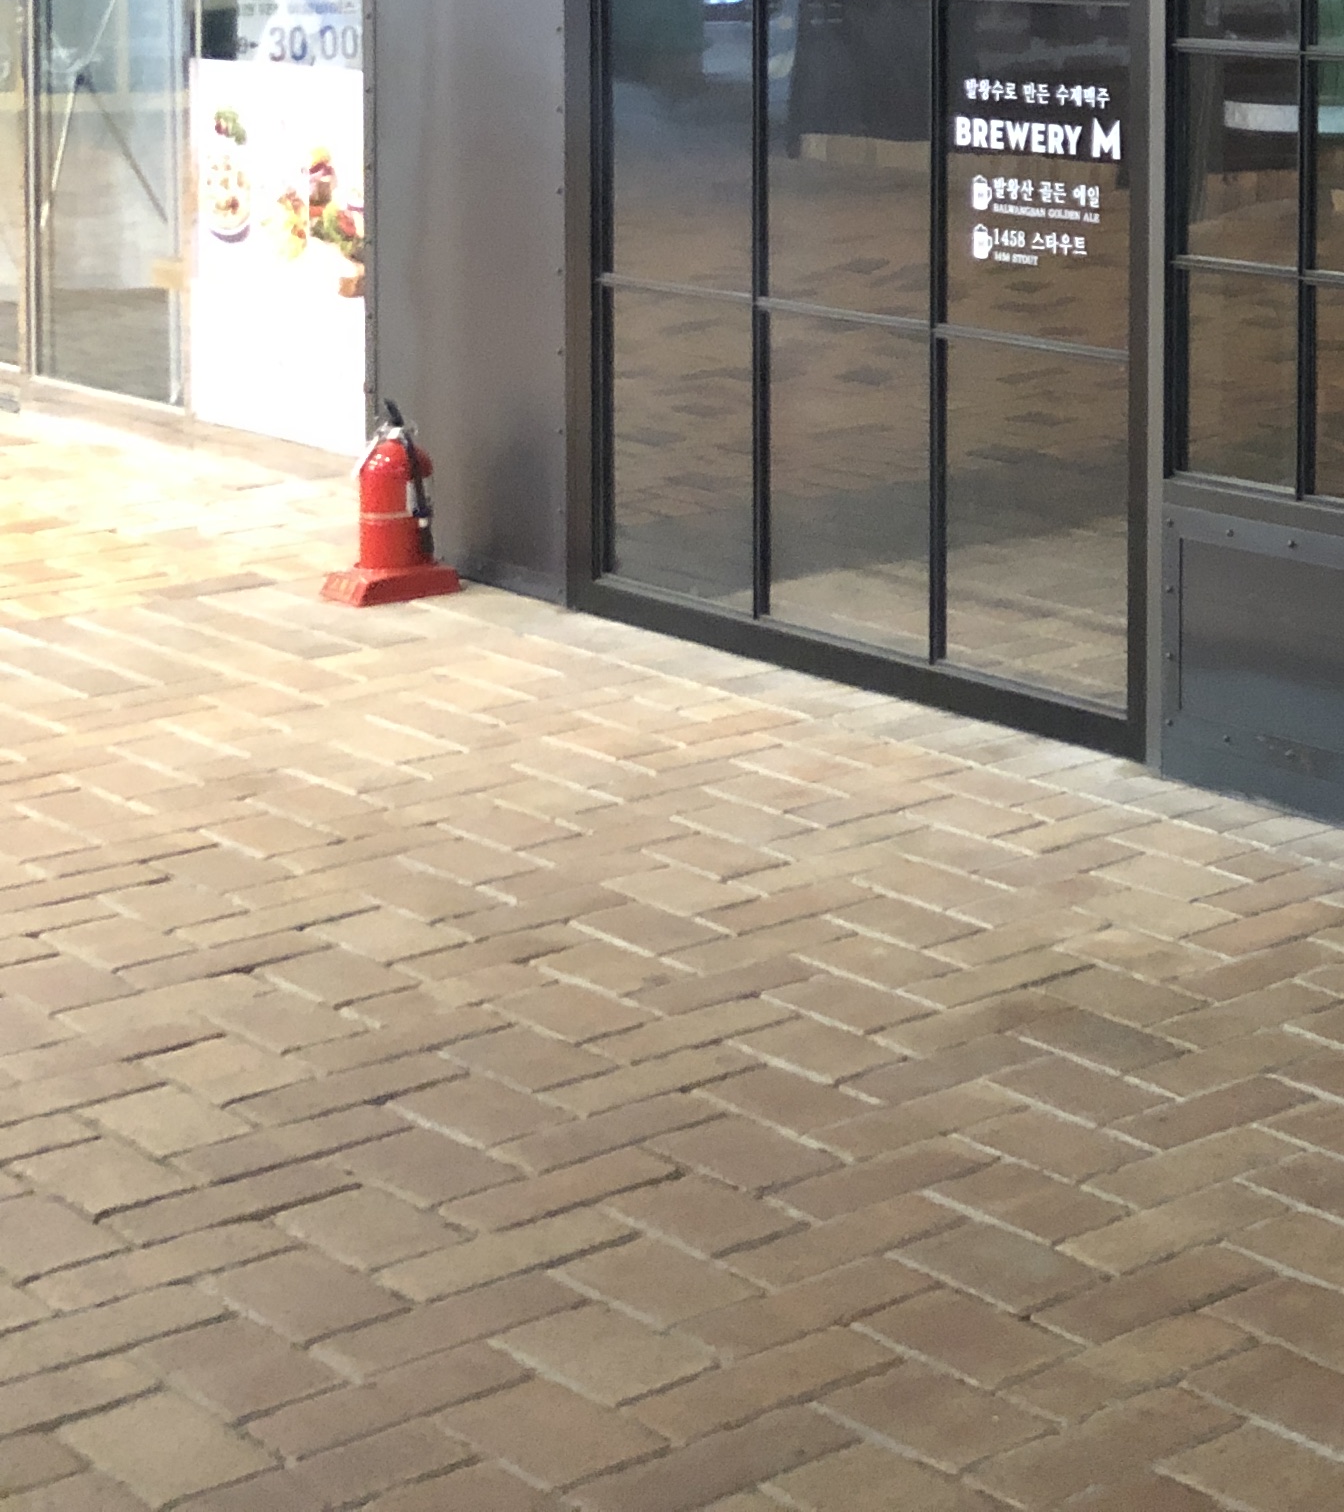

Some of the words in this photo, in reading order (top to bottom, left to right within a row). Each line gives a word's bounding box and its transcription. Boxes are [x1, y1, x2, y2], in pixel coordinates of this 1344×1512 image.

[965, 78, 1018, 101] 발왕수로
[1023, 82, 1050, 104] 만든
[1056, 85, 1110, 109] 수제맥주
[955, 116, 1082, 155] BREWERY
[1092, 117, 1121, 160] M
[993, 177, 1034, 201] 발왕산
[1039, 181, 1067, 203] 골든
[1073, 184, 1099, 208] 에일
[1083, 212, 1100, 223] ALE
[994, 228, 1025, 248] 1458
[1031, 232, 1087, 256] 스타우트
[1012, 253, 1038, 265] STOUT
